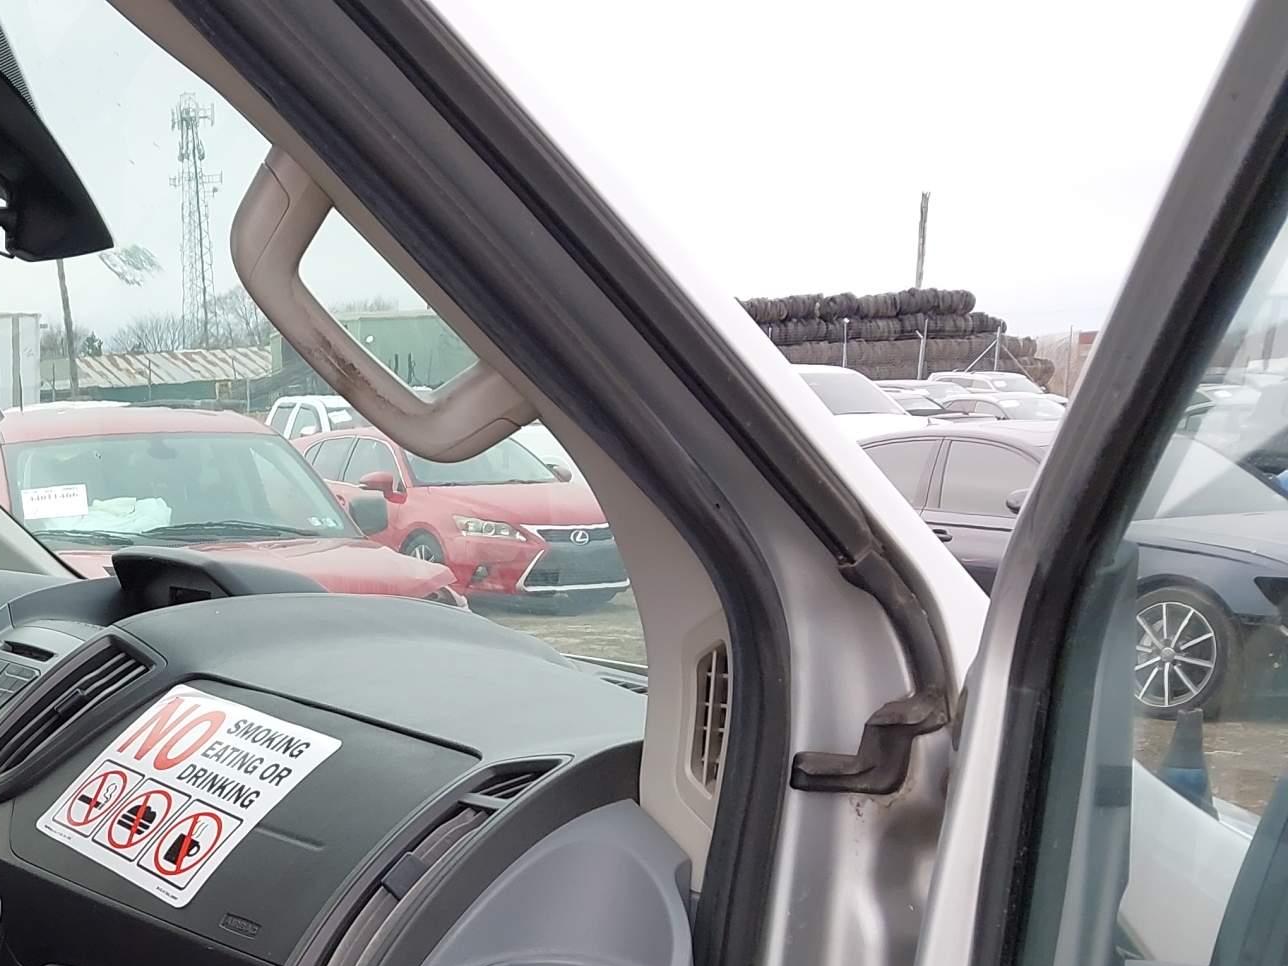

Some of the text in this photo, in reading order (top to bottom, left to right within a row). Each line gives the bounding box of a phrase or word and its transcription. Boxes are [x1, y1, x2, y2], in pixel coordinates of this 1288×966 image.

[117, 696, 227, 771] NO
[226, 718, 311, 760] SMOKING
[175, 763, 262, 811] DRINKING
[200, 740, 293, 787] EATING OR
